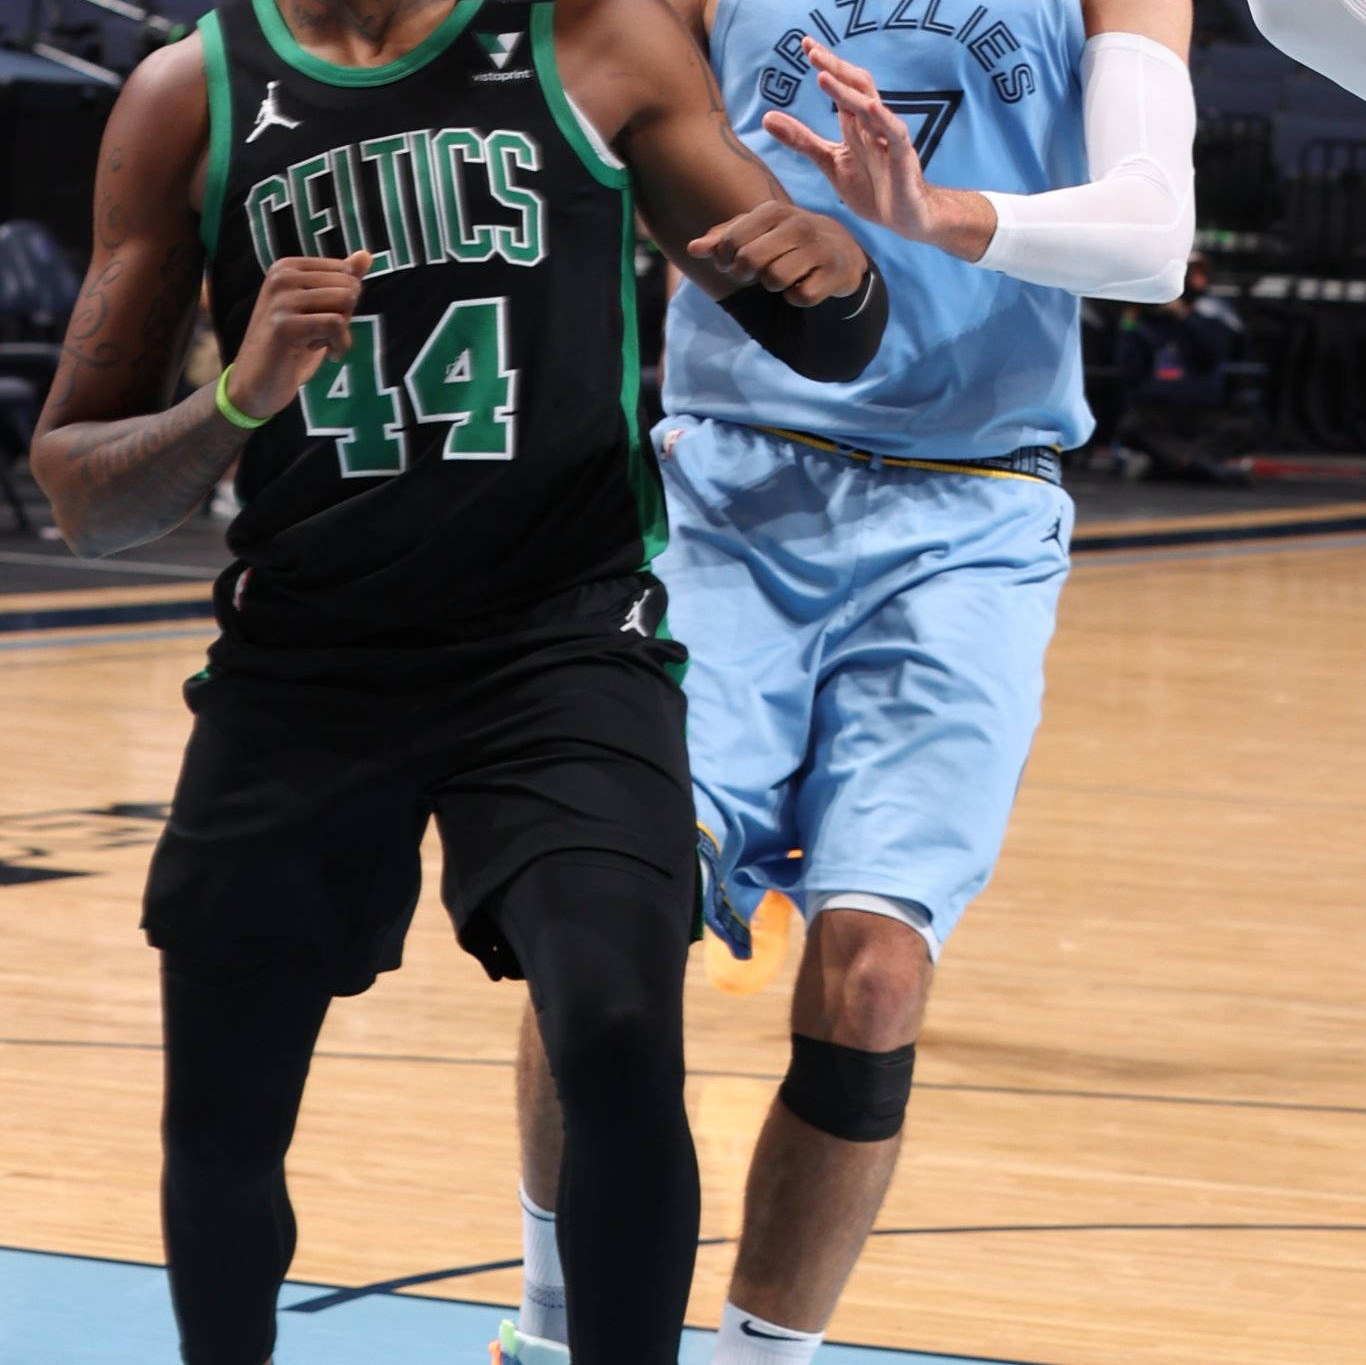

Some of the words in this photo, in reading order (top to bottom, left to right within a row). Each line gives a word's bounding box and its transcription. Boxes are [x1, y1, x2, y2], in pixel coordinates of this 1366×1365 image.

[471, 69, 532, 83] vistaprint
[245, 127, 543, 282] CELTICS
[299, 296, 519, 479] 44
